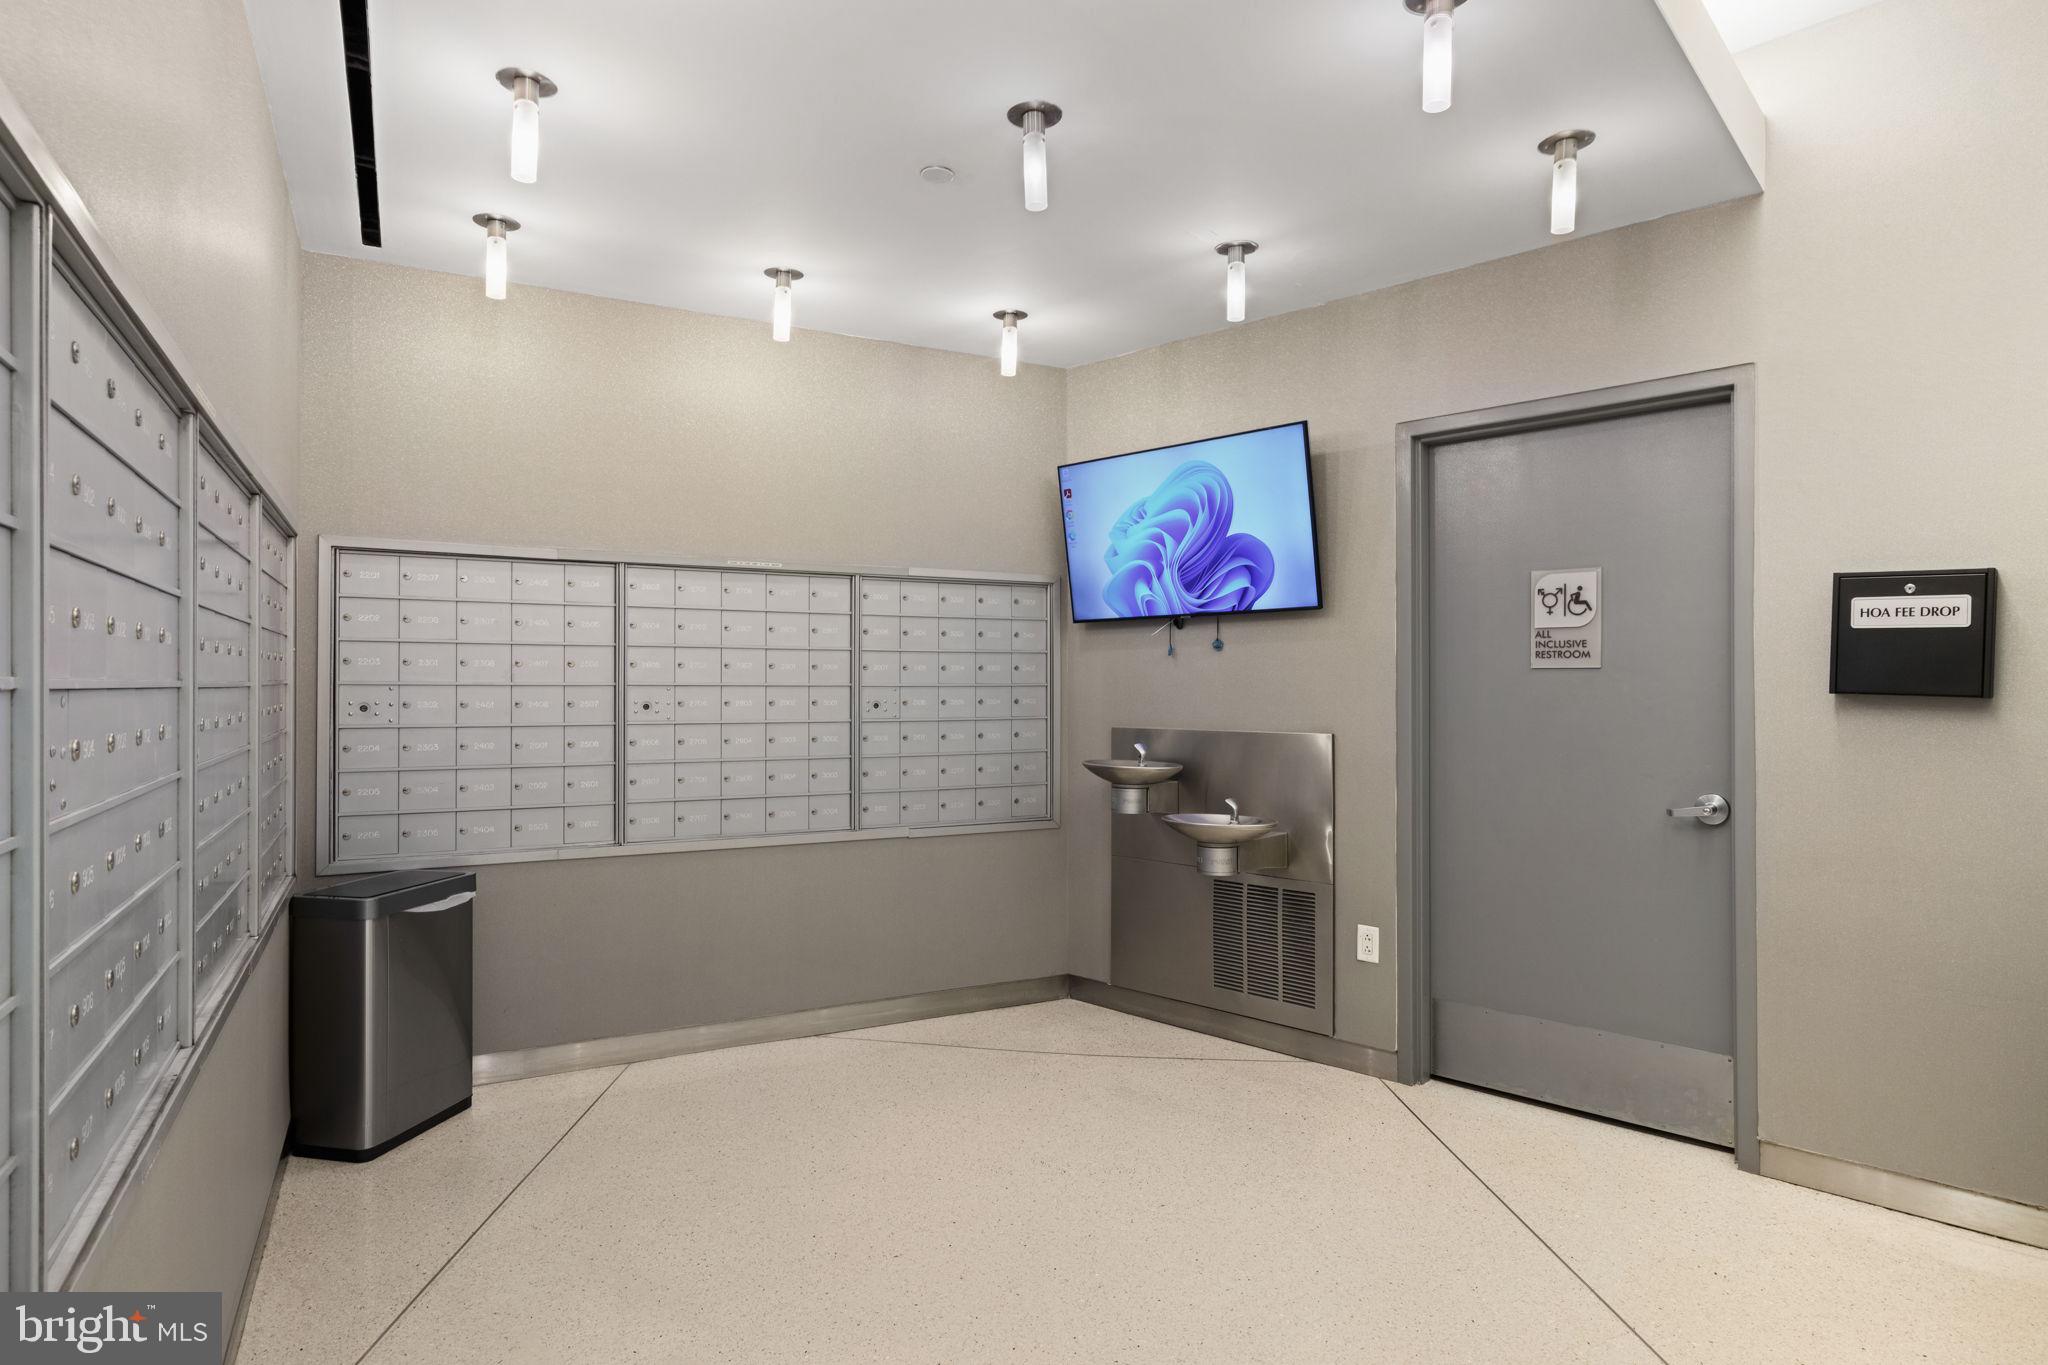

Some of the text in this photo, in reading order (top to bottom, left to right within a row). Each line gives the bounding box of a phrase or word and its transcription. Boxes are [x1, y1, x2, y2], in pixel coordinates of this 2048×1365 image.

[1860, 606, 1961, 618] HOA FEE DROP
[1534, 629, 1552, 639] ALL
[1535, 640, 1588, 649] INCLUSIVE
[1535, 650, 1592, 659] RESTROOM
[357, 743, 380, 752] 2204
